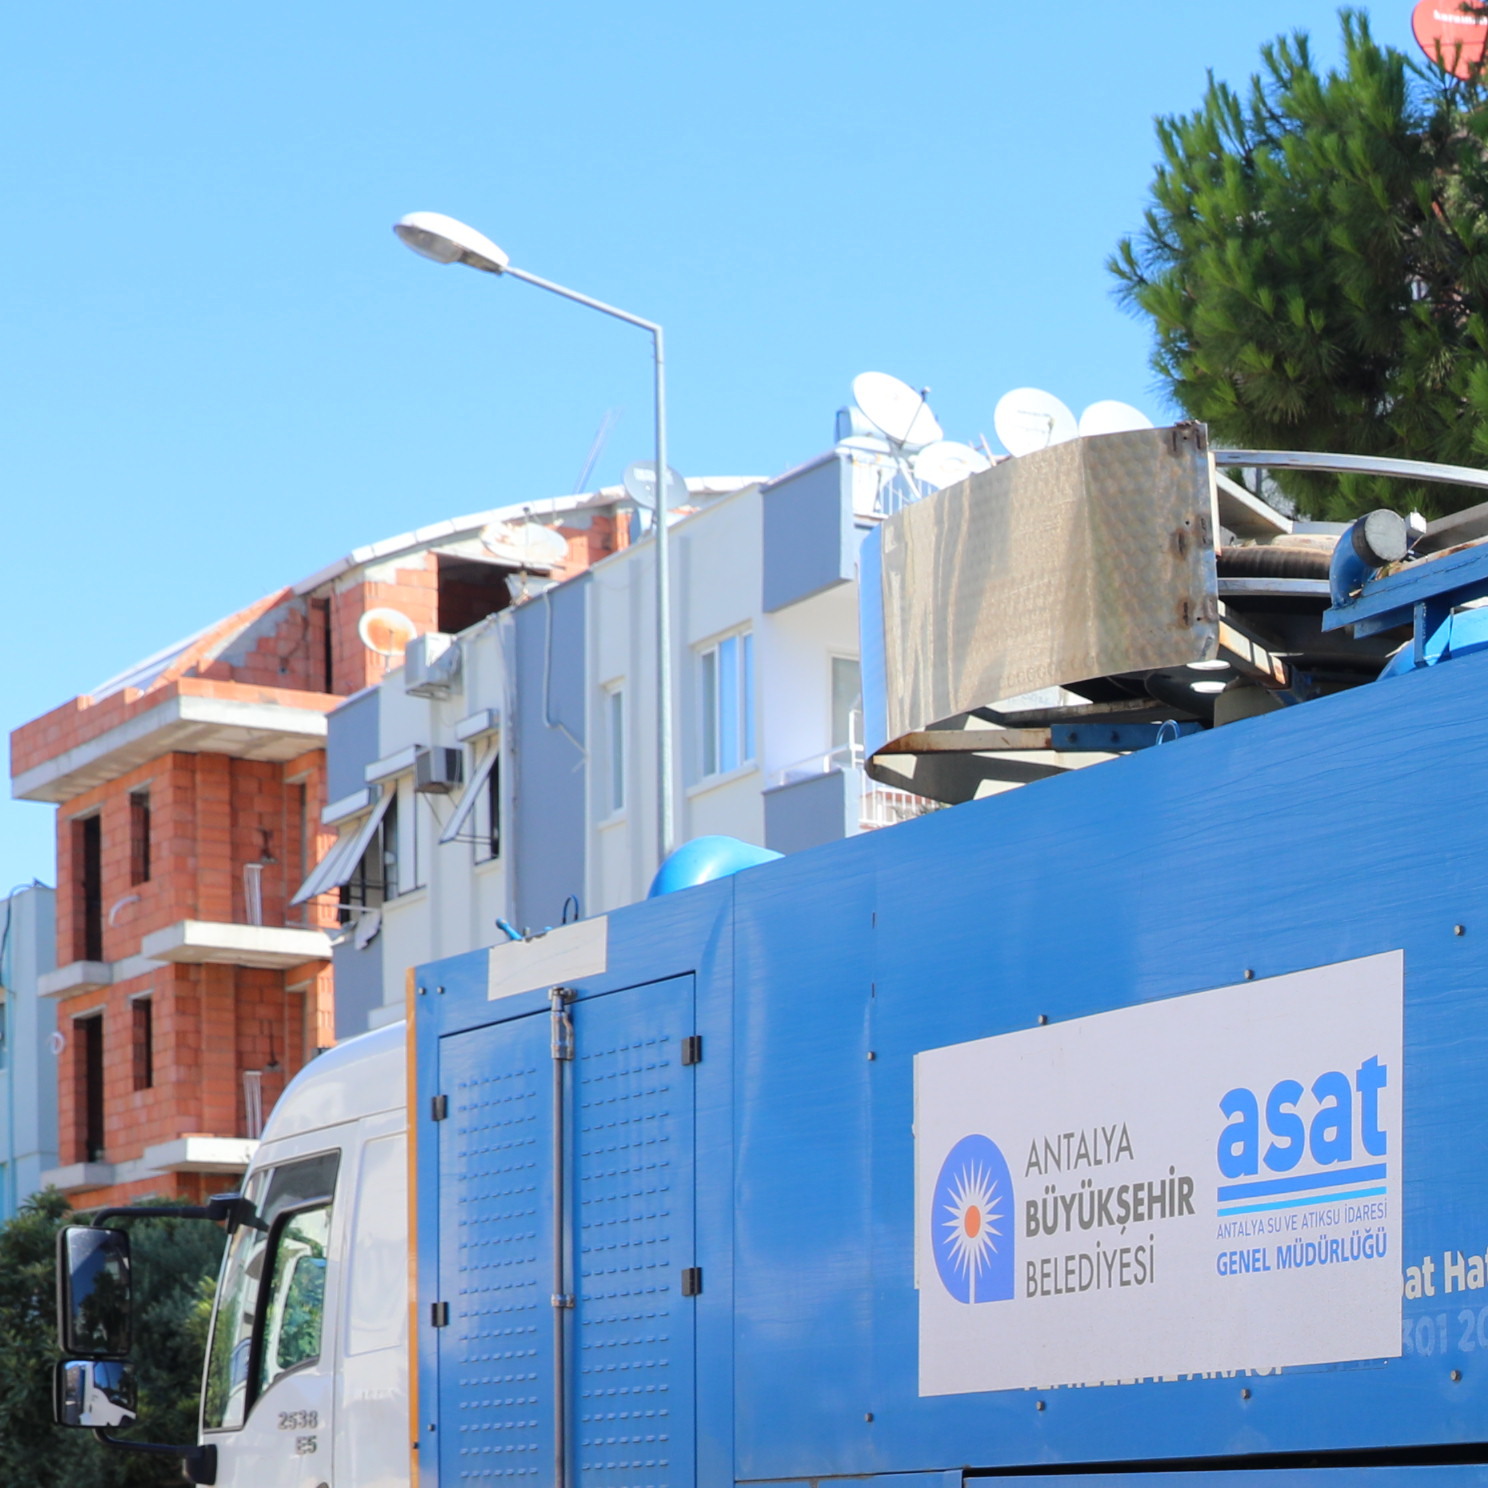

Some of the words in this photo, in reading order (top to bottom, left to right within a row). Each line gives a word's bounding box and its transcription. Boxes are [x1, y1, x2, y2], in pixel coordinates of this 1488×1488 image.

[1217, 1054, 1388, 1179] asat
[1025, 1120, 1135, 1178] ANTALYA
[1025, 1164, 1196, 1237] BÜYÜKŞEHİR
[1216, 1220, 1265, 1240] ANTALYA
[1267, 1217, 1282, 1234] SU
[1284, 1214, 1299, 1231] VE
[1301, 1208, 1341, 1230] ATIKSU
[1344, 1198, 1388, 1223] İDARESİ
[1026, 1233, 1154, 1298] BELEDİYESİ
[1216, 1247, 1272, 1276] GENEL
[1276, 1226, 1388, 1270] MÜDÜRLÜĞÜ
[1401, 1256, 1436, 1300] at
[277, 1409, 319, 1430] 2538
